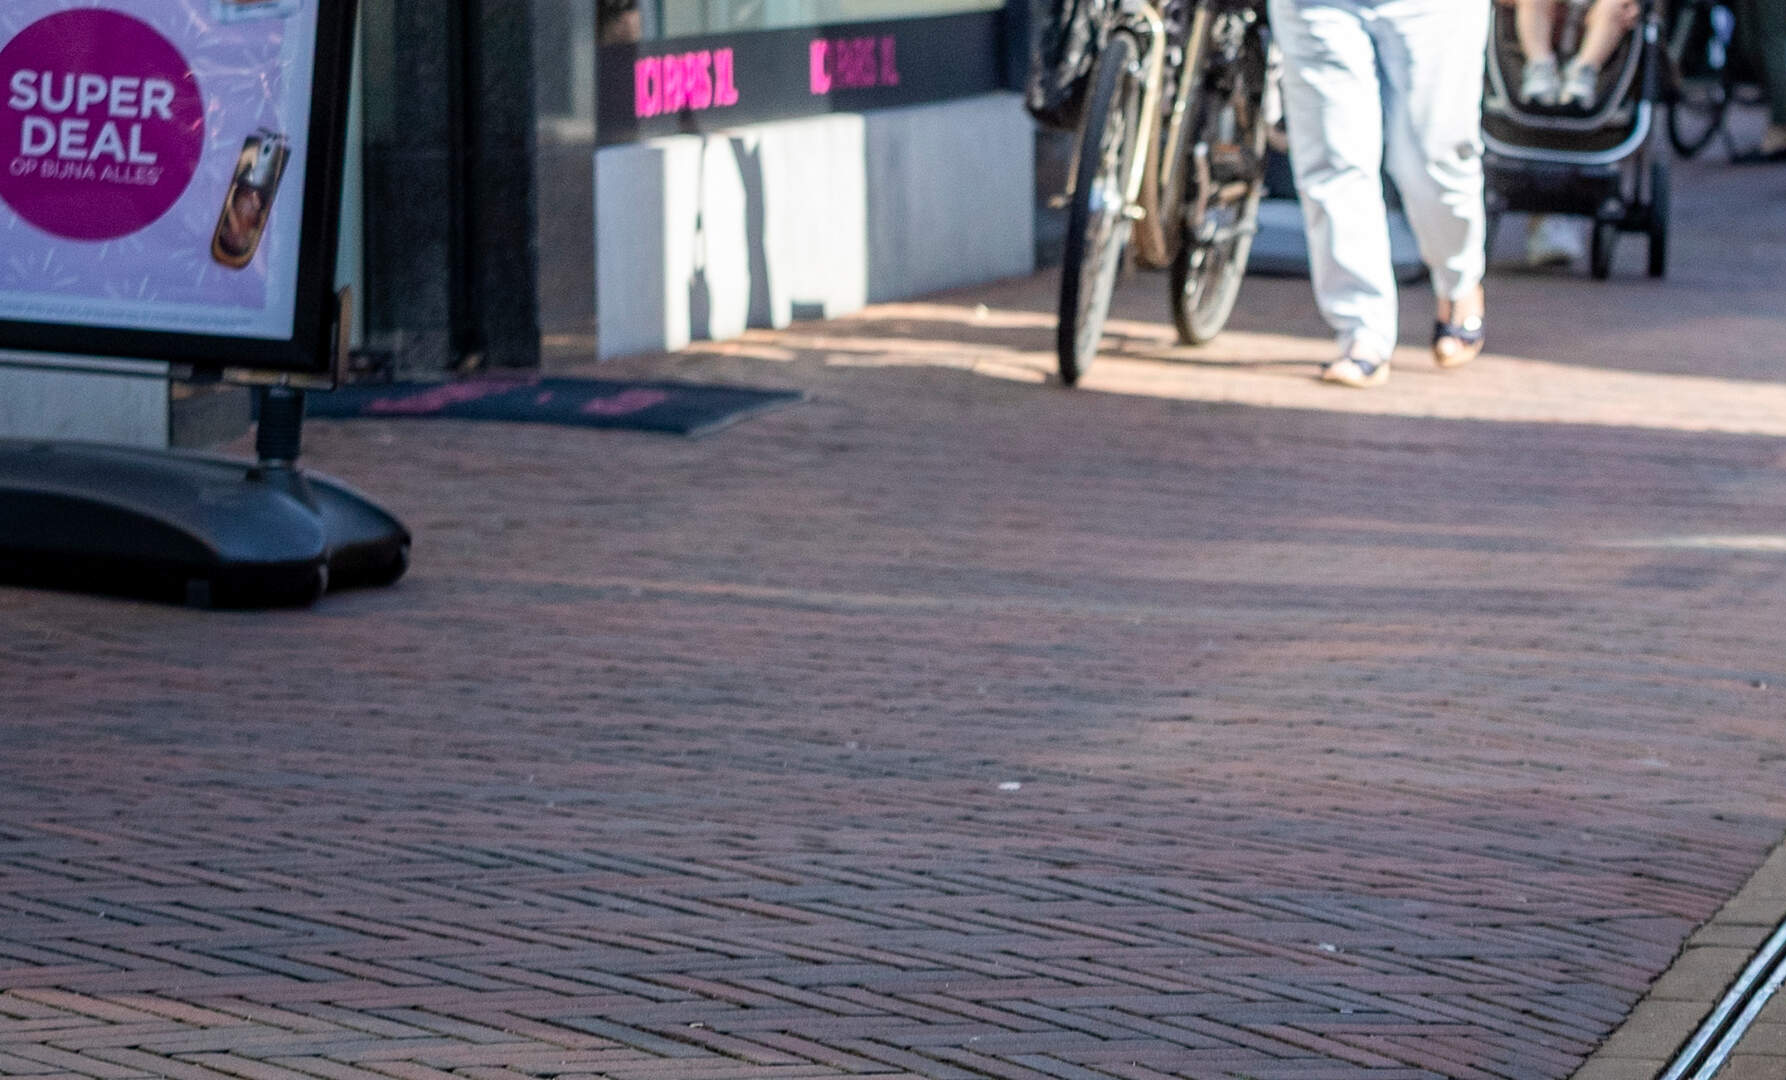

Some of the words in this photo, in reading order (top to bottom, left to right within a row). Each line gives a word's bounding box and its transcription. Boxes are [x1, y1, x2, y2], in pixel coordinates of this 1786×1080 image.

[8, 69, 176, 121] SUPER
[20, 115, 158, 164] DEAL
[9, 156, 38, 177] OP
[40, 158, 97, 182] BIJNA
